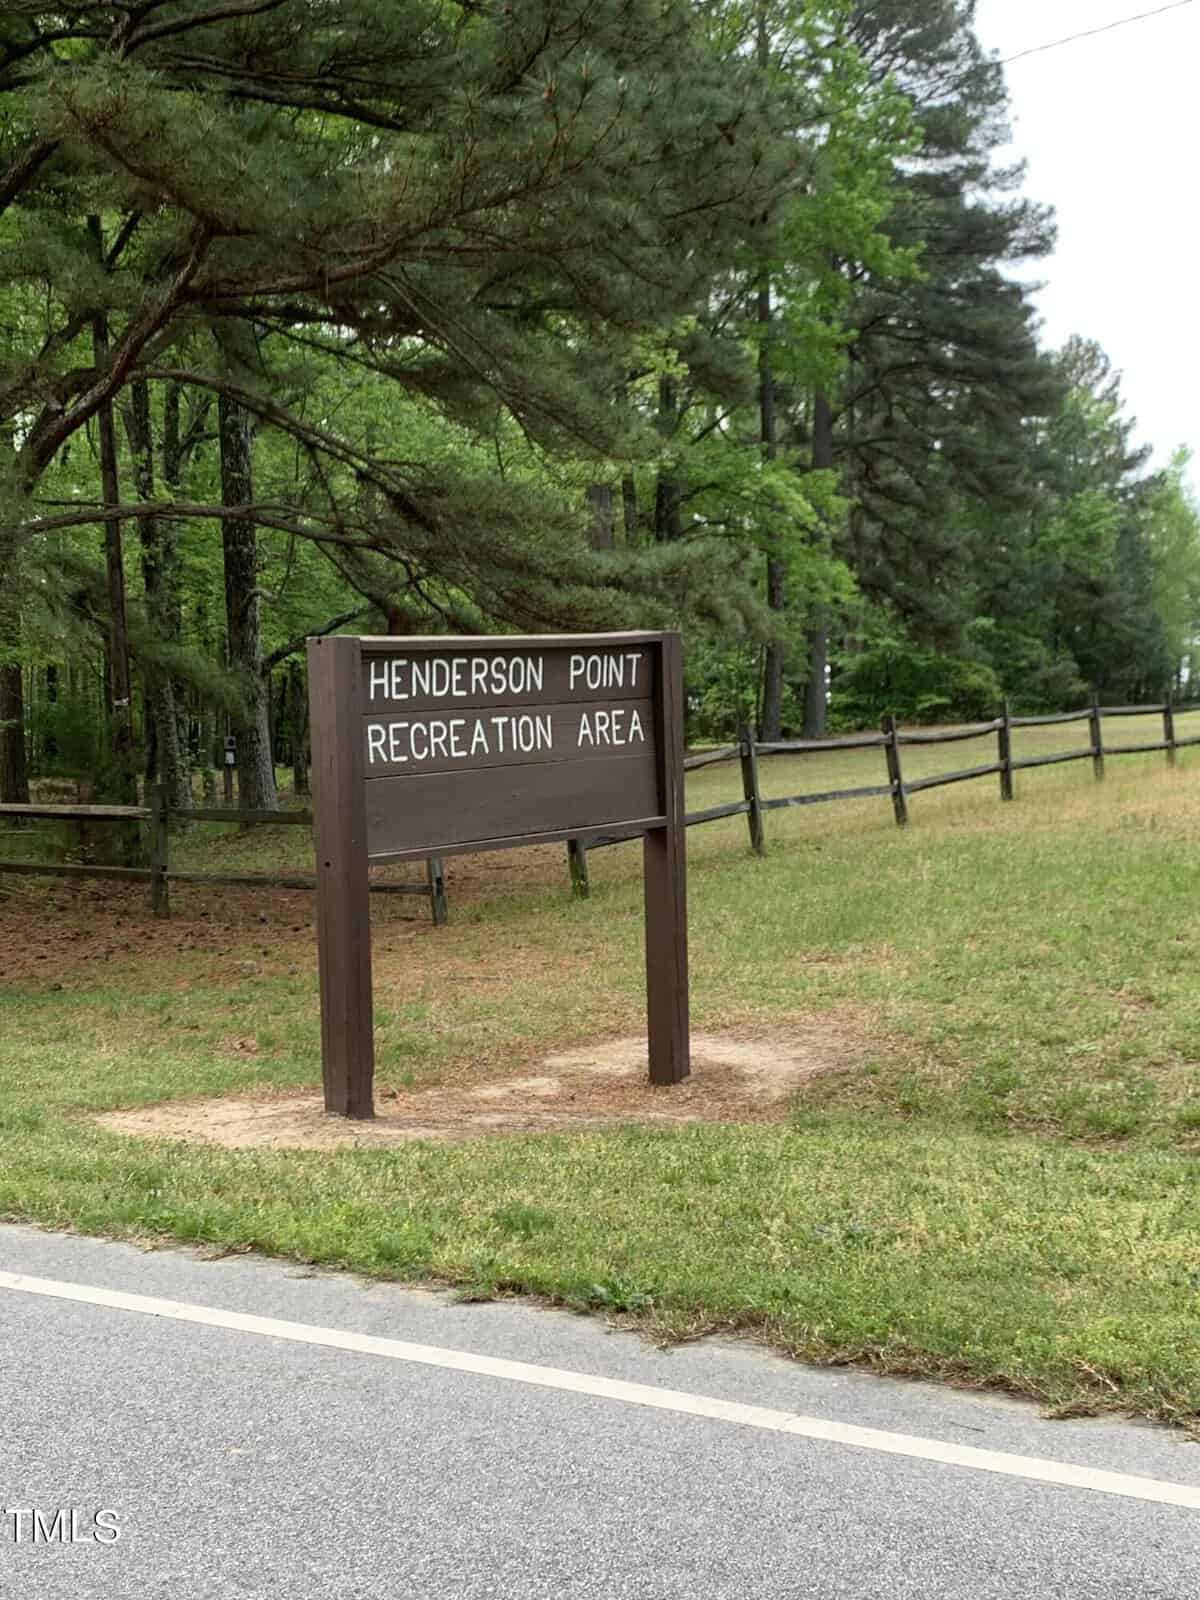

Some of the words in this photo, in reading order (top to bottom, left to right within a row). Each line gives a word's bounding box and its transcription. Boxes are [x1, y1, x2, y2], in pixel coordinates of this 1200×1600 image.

[369, 656, 543, 700] HENDERSON
[569, 653, 642, 690] POINT
[367, 715, 552, 764] RECREATION
[577, 710, 645, 747] AREA
